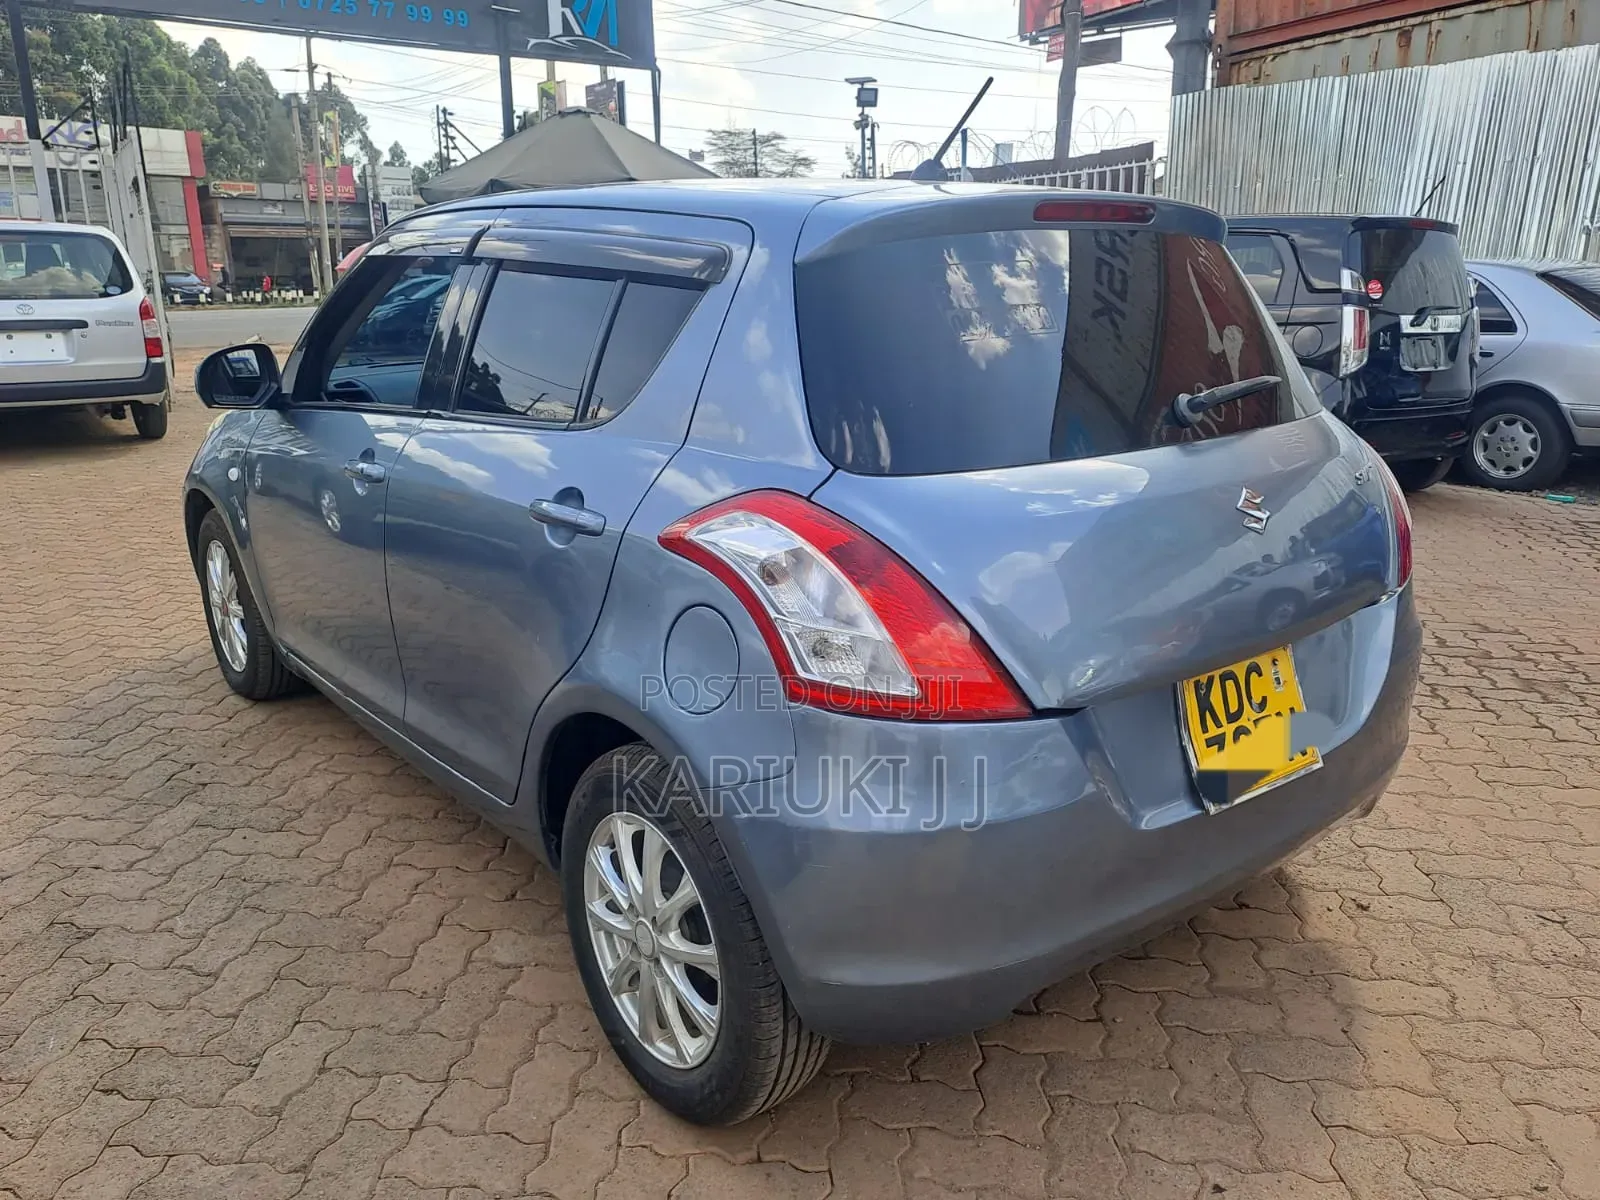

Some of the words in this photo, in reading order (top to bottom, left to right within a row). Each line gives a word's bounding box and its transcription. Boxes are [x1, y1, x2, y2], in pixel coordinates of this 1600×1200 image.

[367, 0, 395, 18] 77
[405, 4, 433, 23] 99
[443, 8, 469, 28] 99
[1193, 660, 1268, 734] KDC
